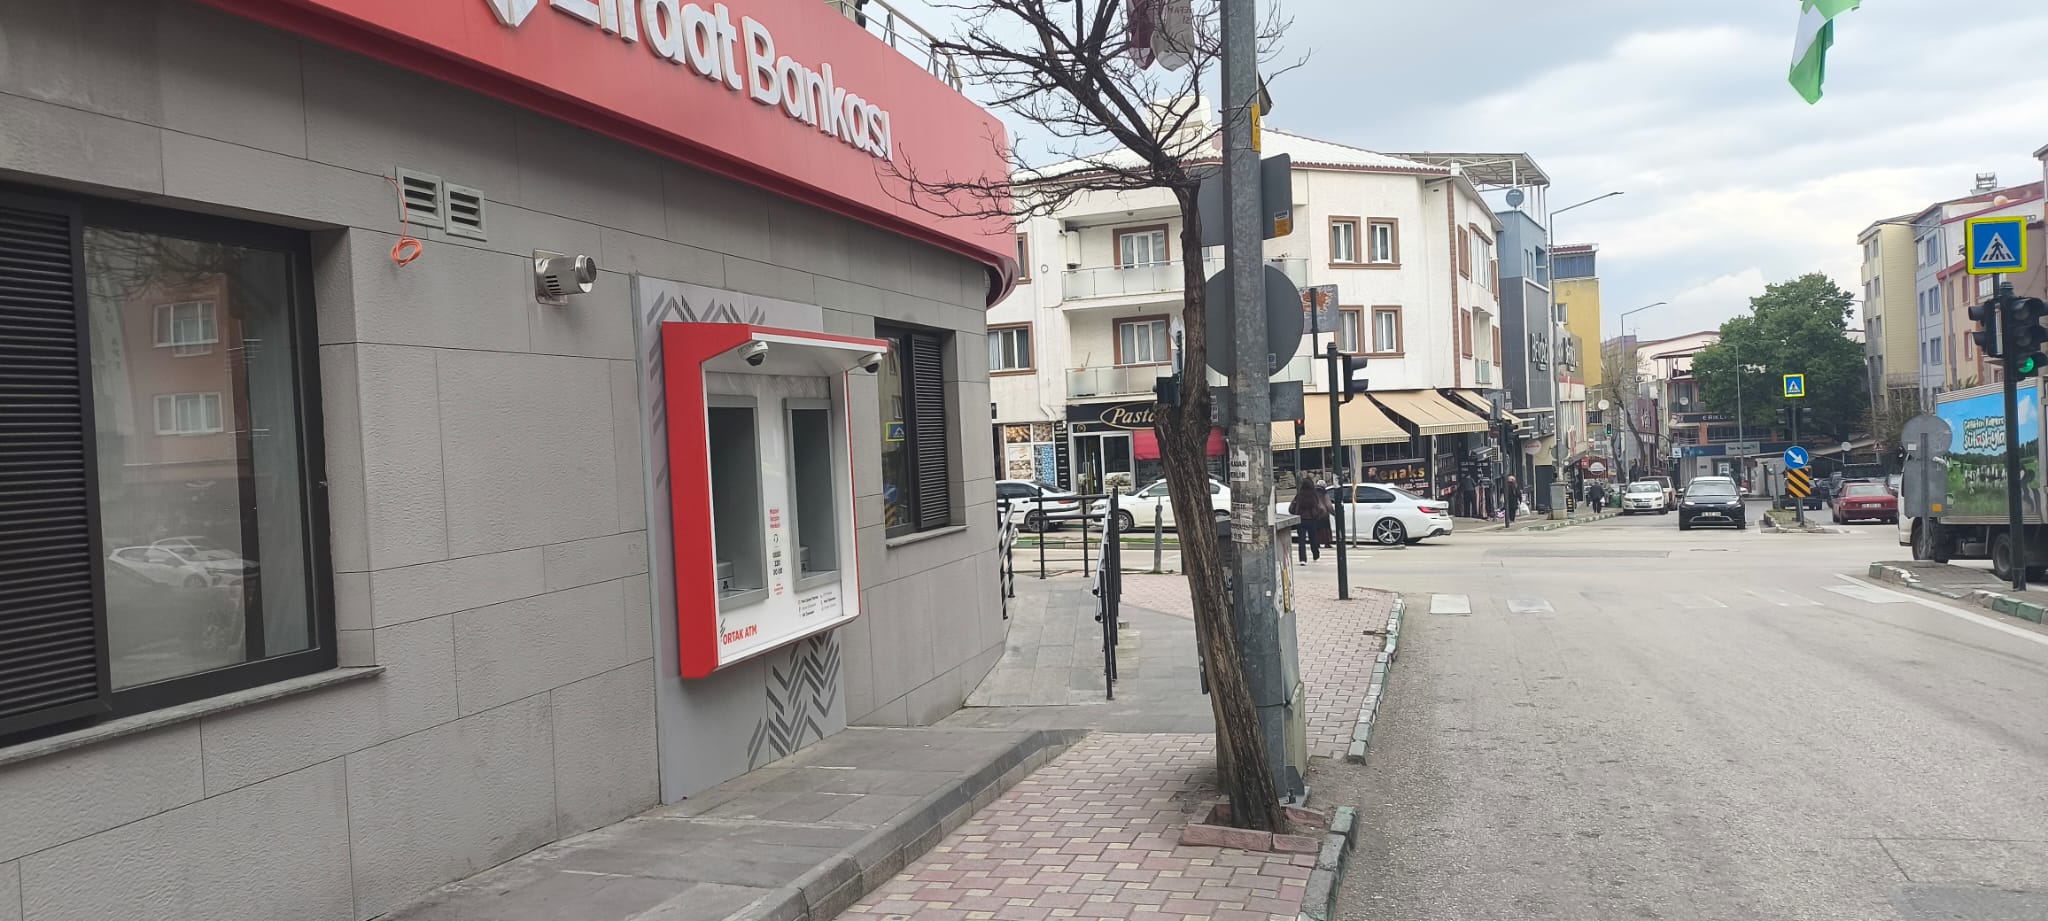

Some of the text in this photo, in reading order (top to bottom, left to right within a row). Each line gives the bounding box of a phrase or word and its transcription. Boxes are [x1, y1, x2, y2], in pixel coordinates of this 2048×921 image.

[742, 15, 894, 162] Bankası
[722, 623, 758, 646] ORTAK ATM
